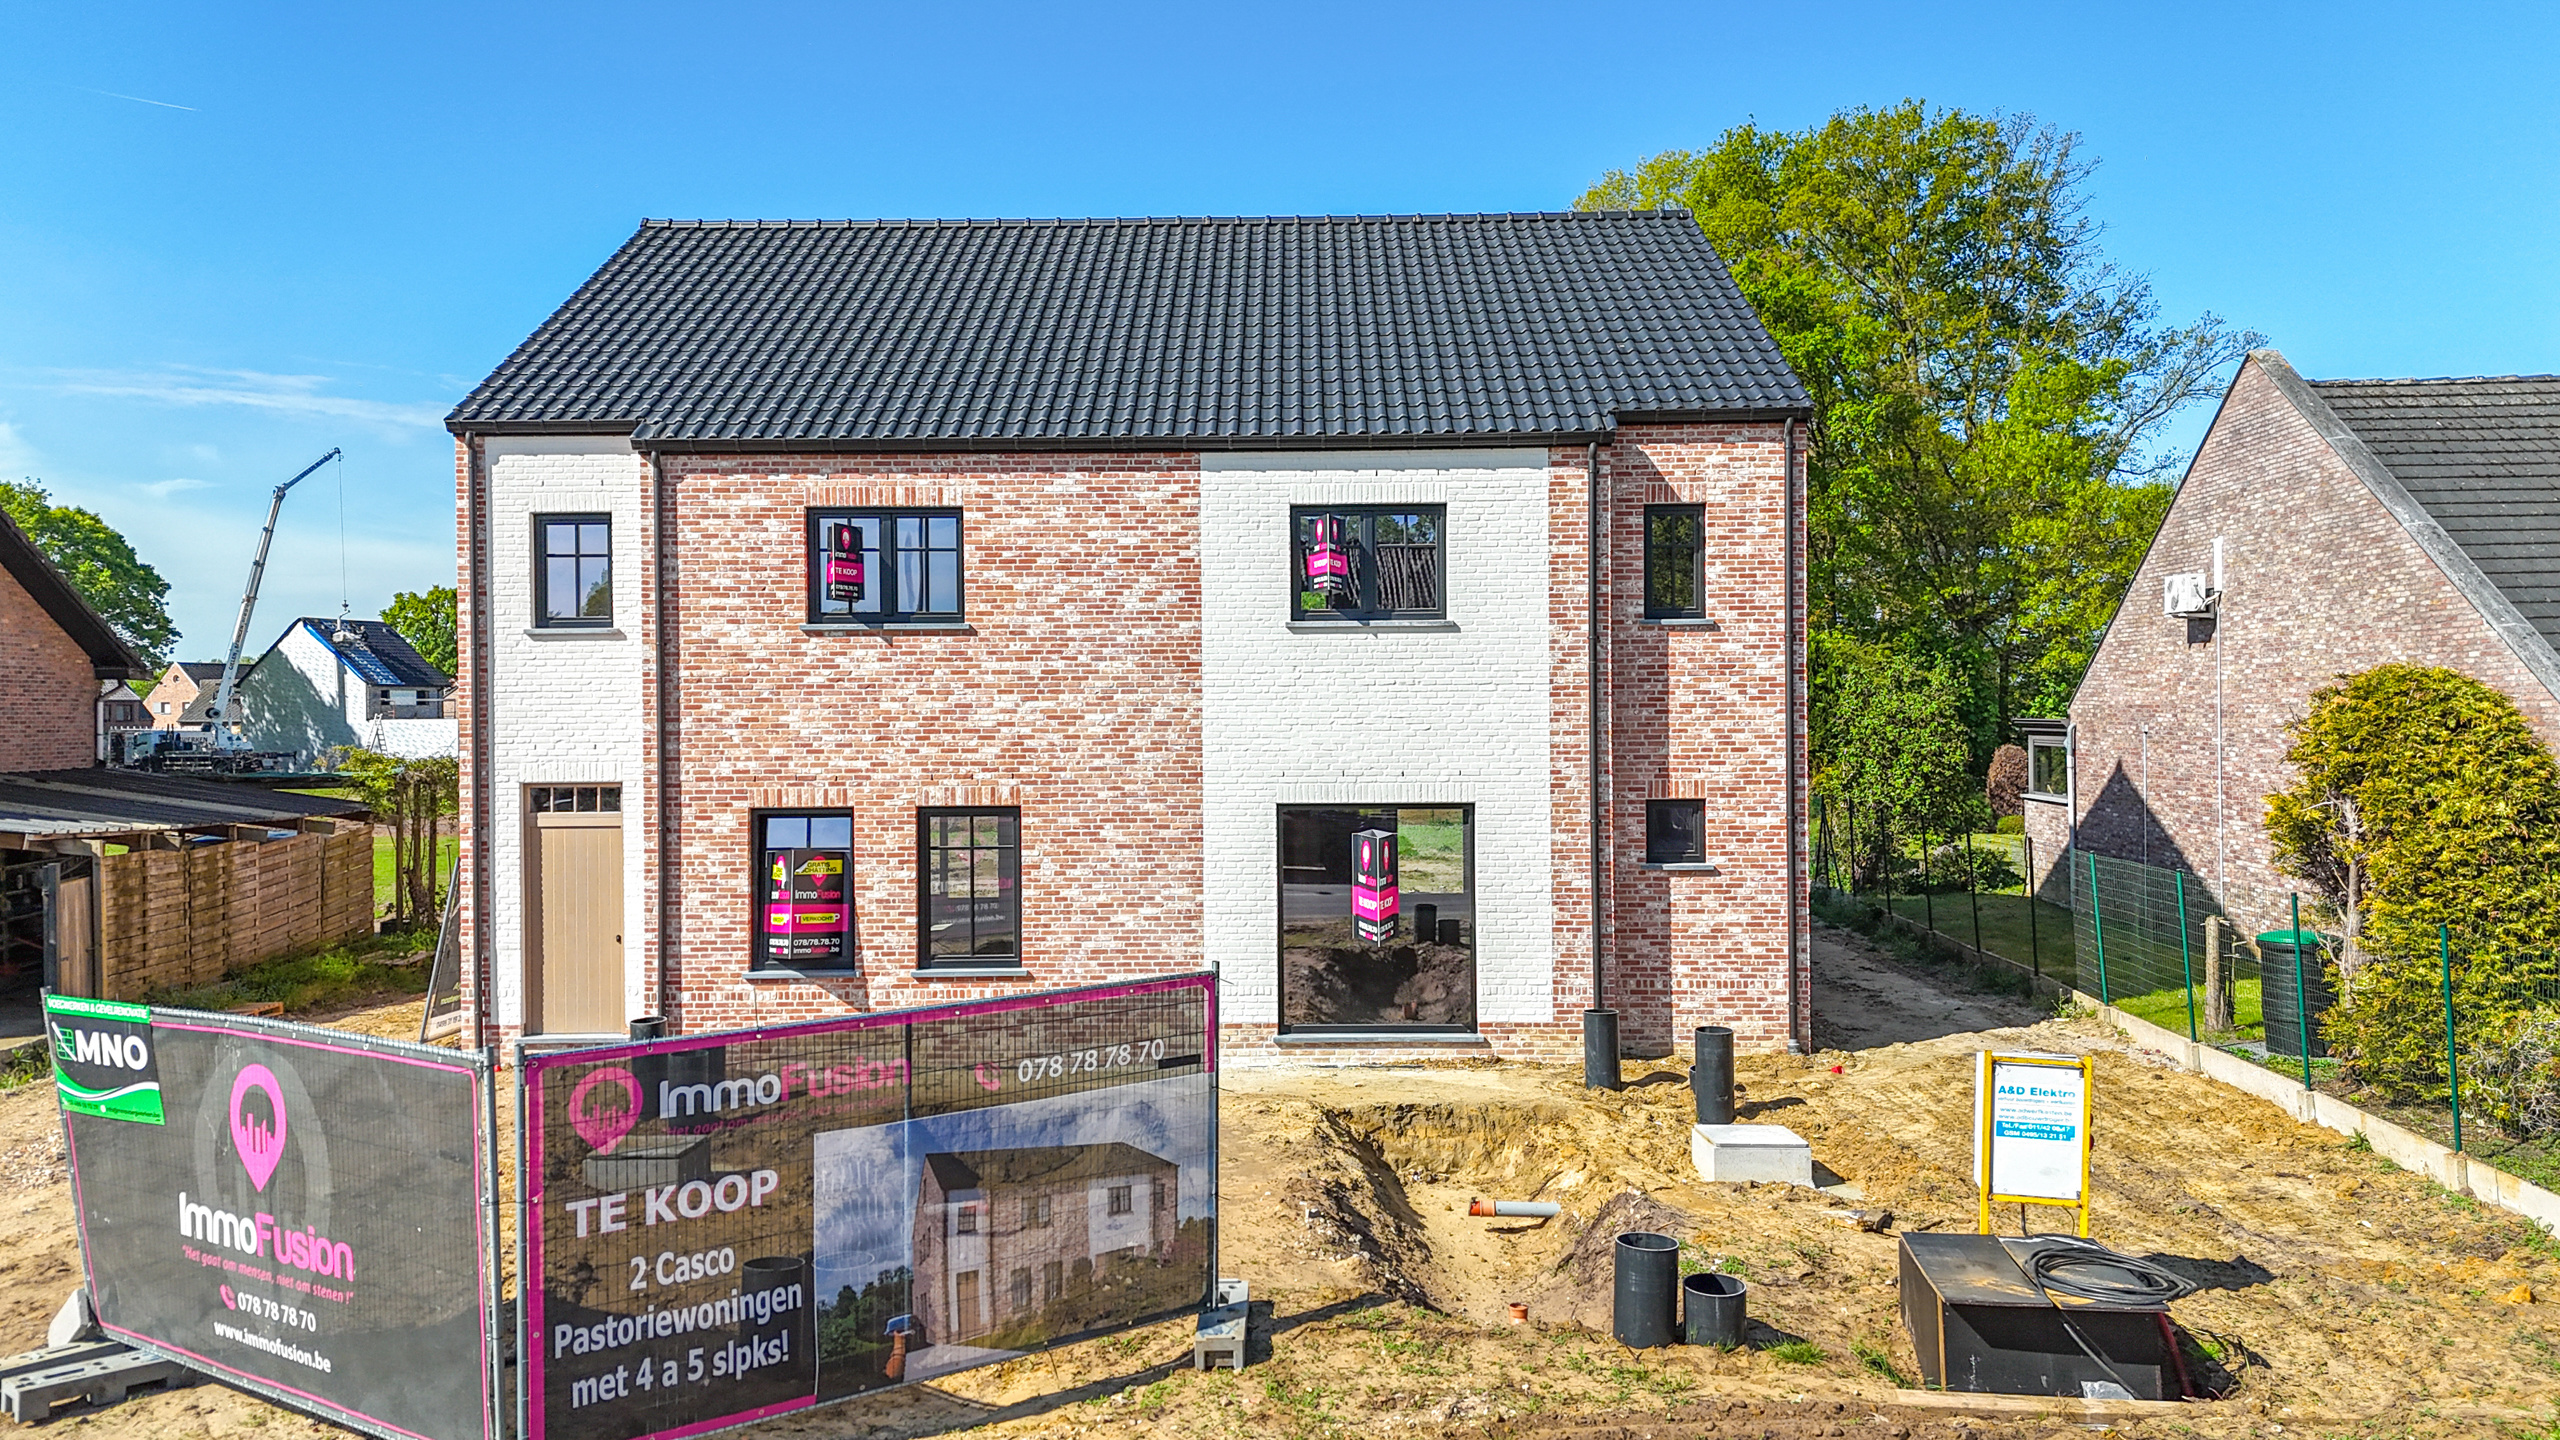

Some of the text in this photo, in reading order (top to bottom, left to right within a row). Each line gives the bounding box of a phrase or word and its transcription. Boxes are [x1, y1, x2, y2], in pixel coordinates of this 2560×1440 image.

[843, 568, 858, 576] KOOP
[794, 890, 841, 900] ImmoFusion
[802, 914, 834, 922] VERKOCHT
[793, 938, 840, 946] 078/78.78.70
[74, 1029, 148, 1070] MNO
[1018, 1038, 1165, 1082] 078 78 78 70
[659, 1056, 912, 1119] ImmoFusion
[1998, 1086, 2076, 1098] A&D Elektro
[565, 1169, 780, 1239] TE KOOP
[178, 1192, 354, 1282] ImmoFusion
[222, 1259, 236, 1272] om
[238, 1262, 275, 1284] mensen,
[276, 1274, 294, 1289] niet
[295, 1280, 311, 1294] om
[312, 1284, 344, 1302] stenen
[630, 1247, 736, 1291] 2 Casco
[237, 1292, 317, 1333] 078 78 78 70
[554, 1282, 803, 1360] Pastoriewoningen
[213, 1321, 332, 1374] www.immofusion.be
[572, 1328, 790, 1409] met 4 a 5 slpks!
